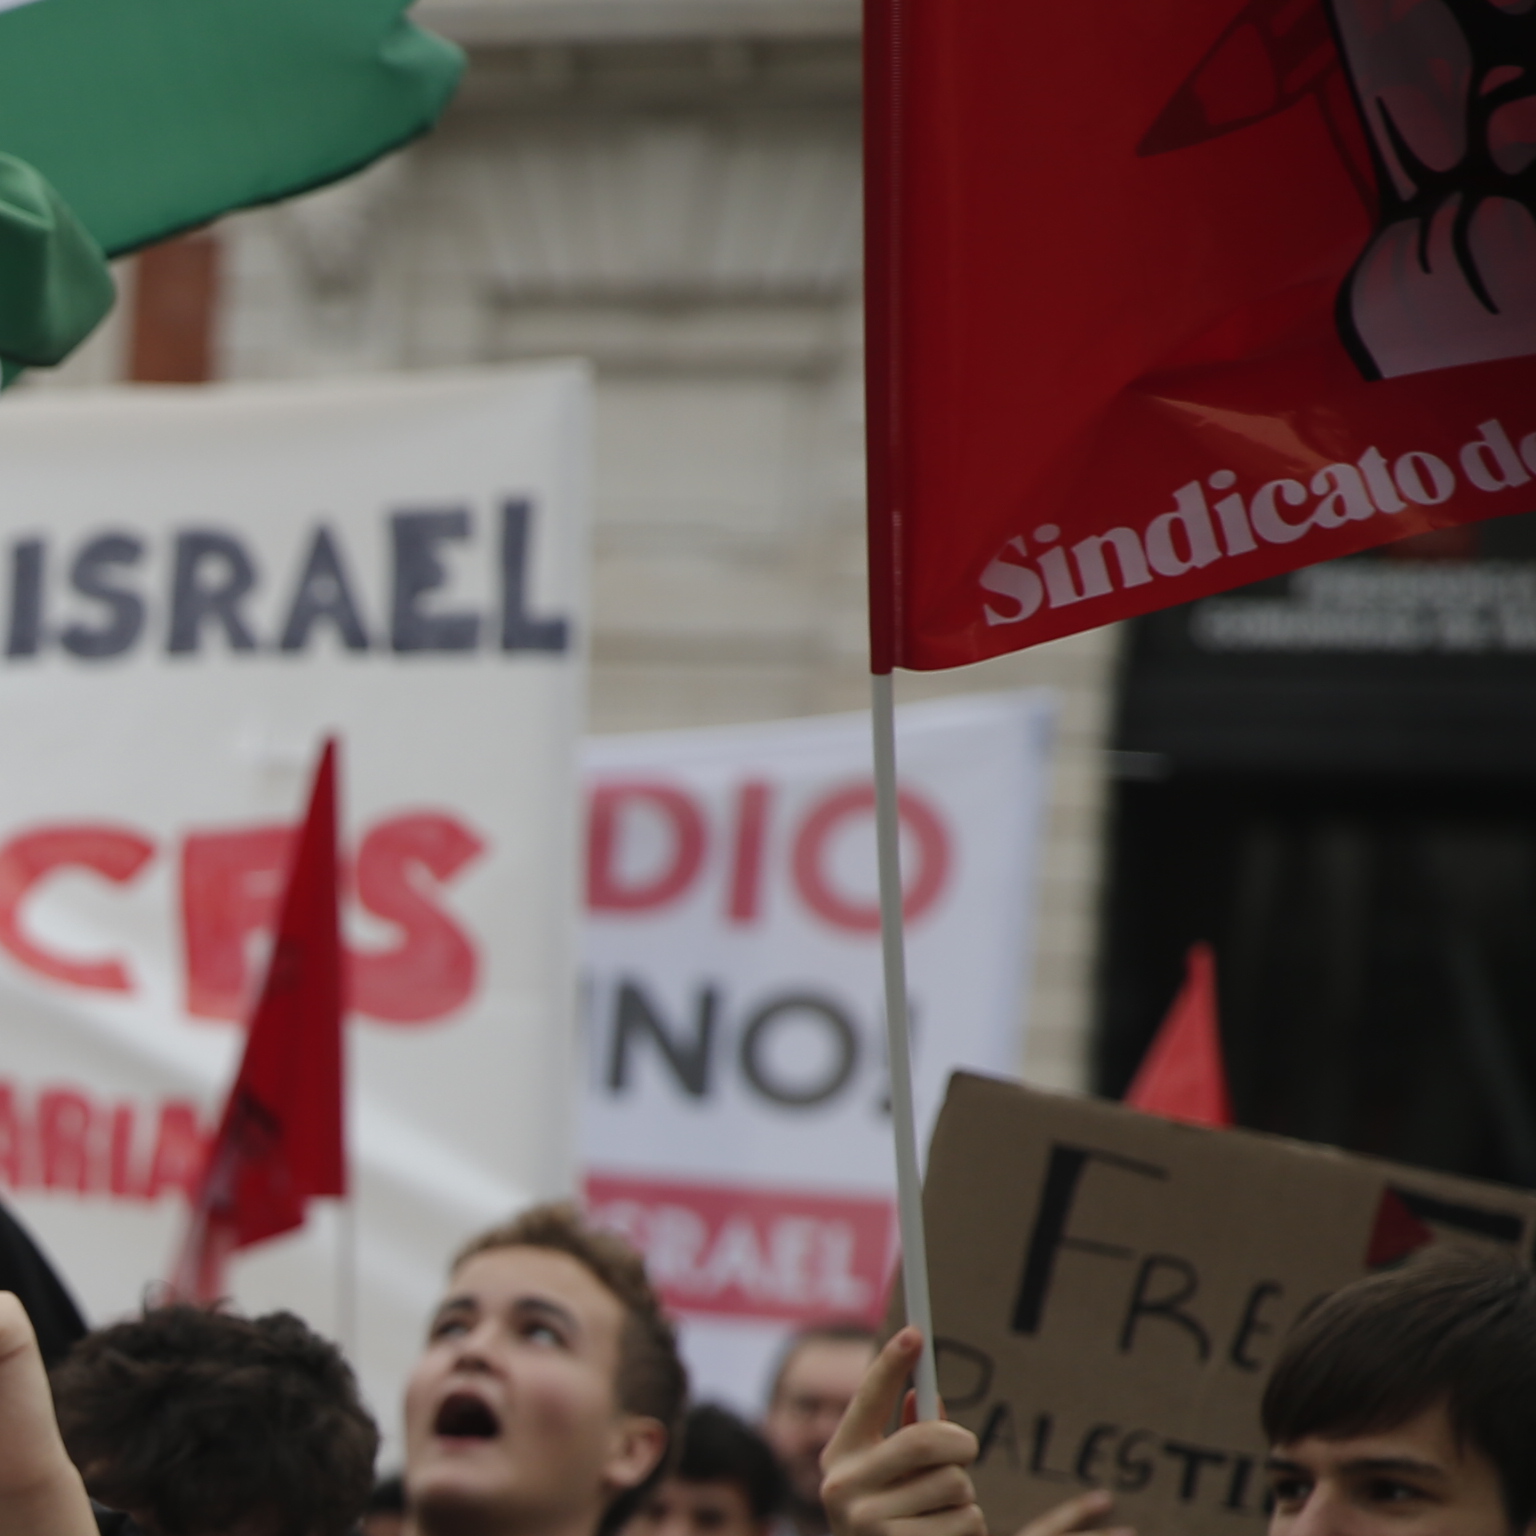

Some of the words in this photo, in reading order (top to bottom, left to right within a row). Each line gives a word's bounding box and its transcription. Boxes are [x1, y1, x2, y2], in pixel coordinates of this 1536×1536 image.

[0, 493, 571, 664] ISRAEL
[977, 445, 1456, 627] Sindicato
[1010, 1143, 1323, 1373] FRE
[928, 1336, 1273, 1517] PALESTI
